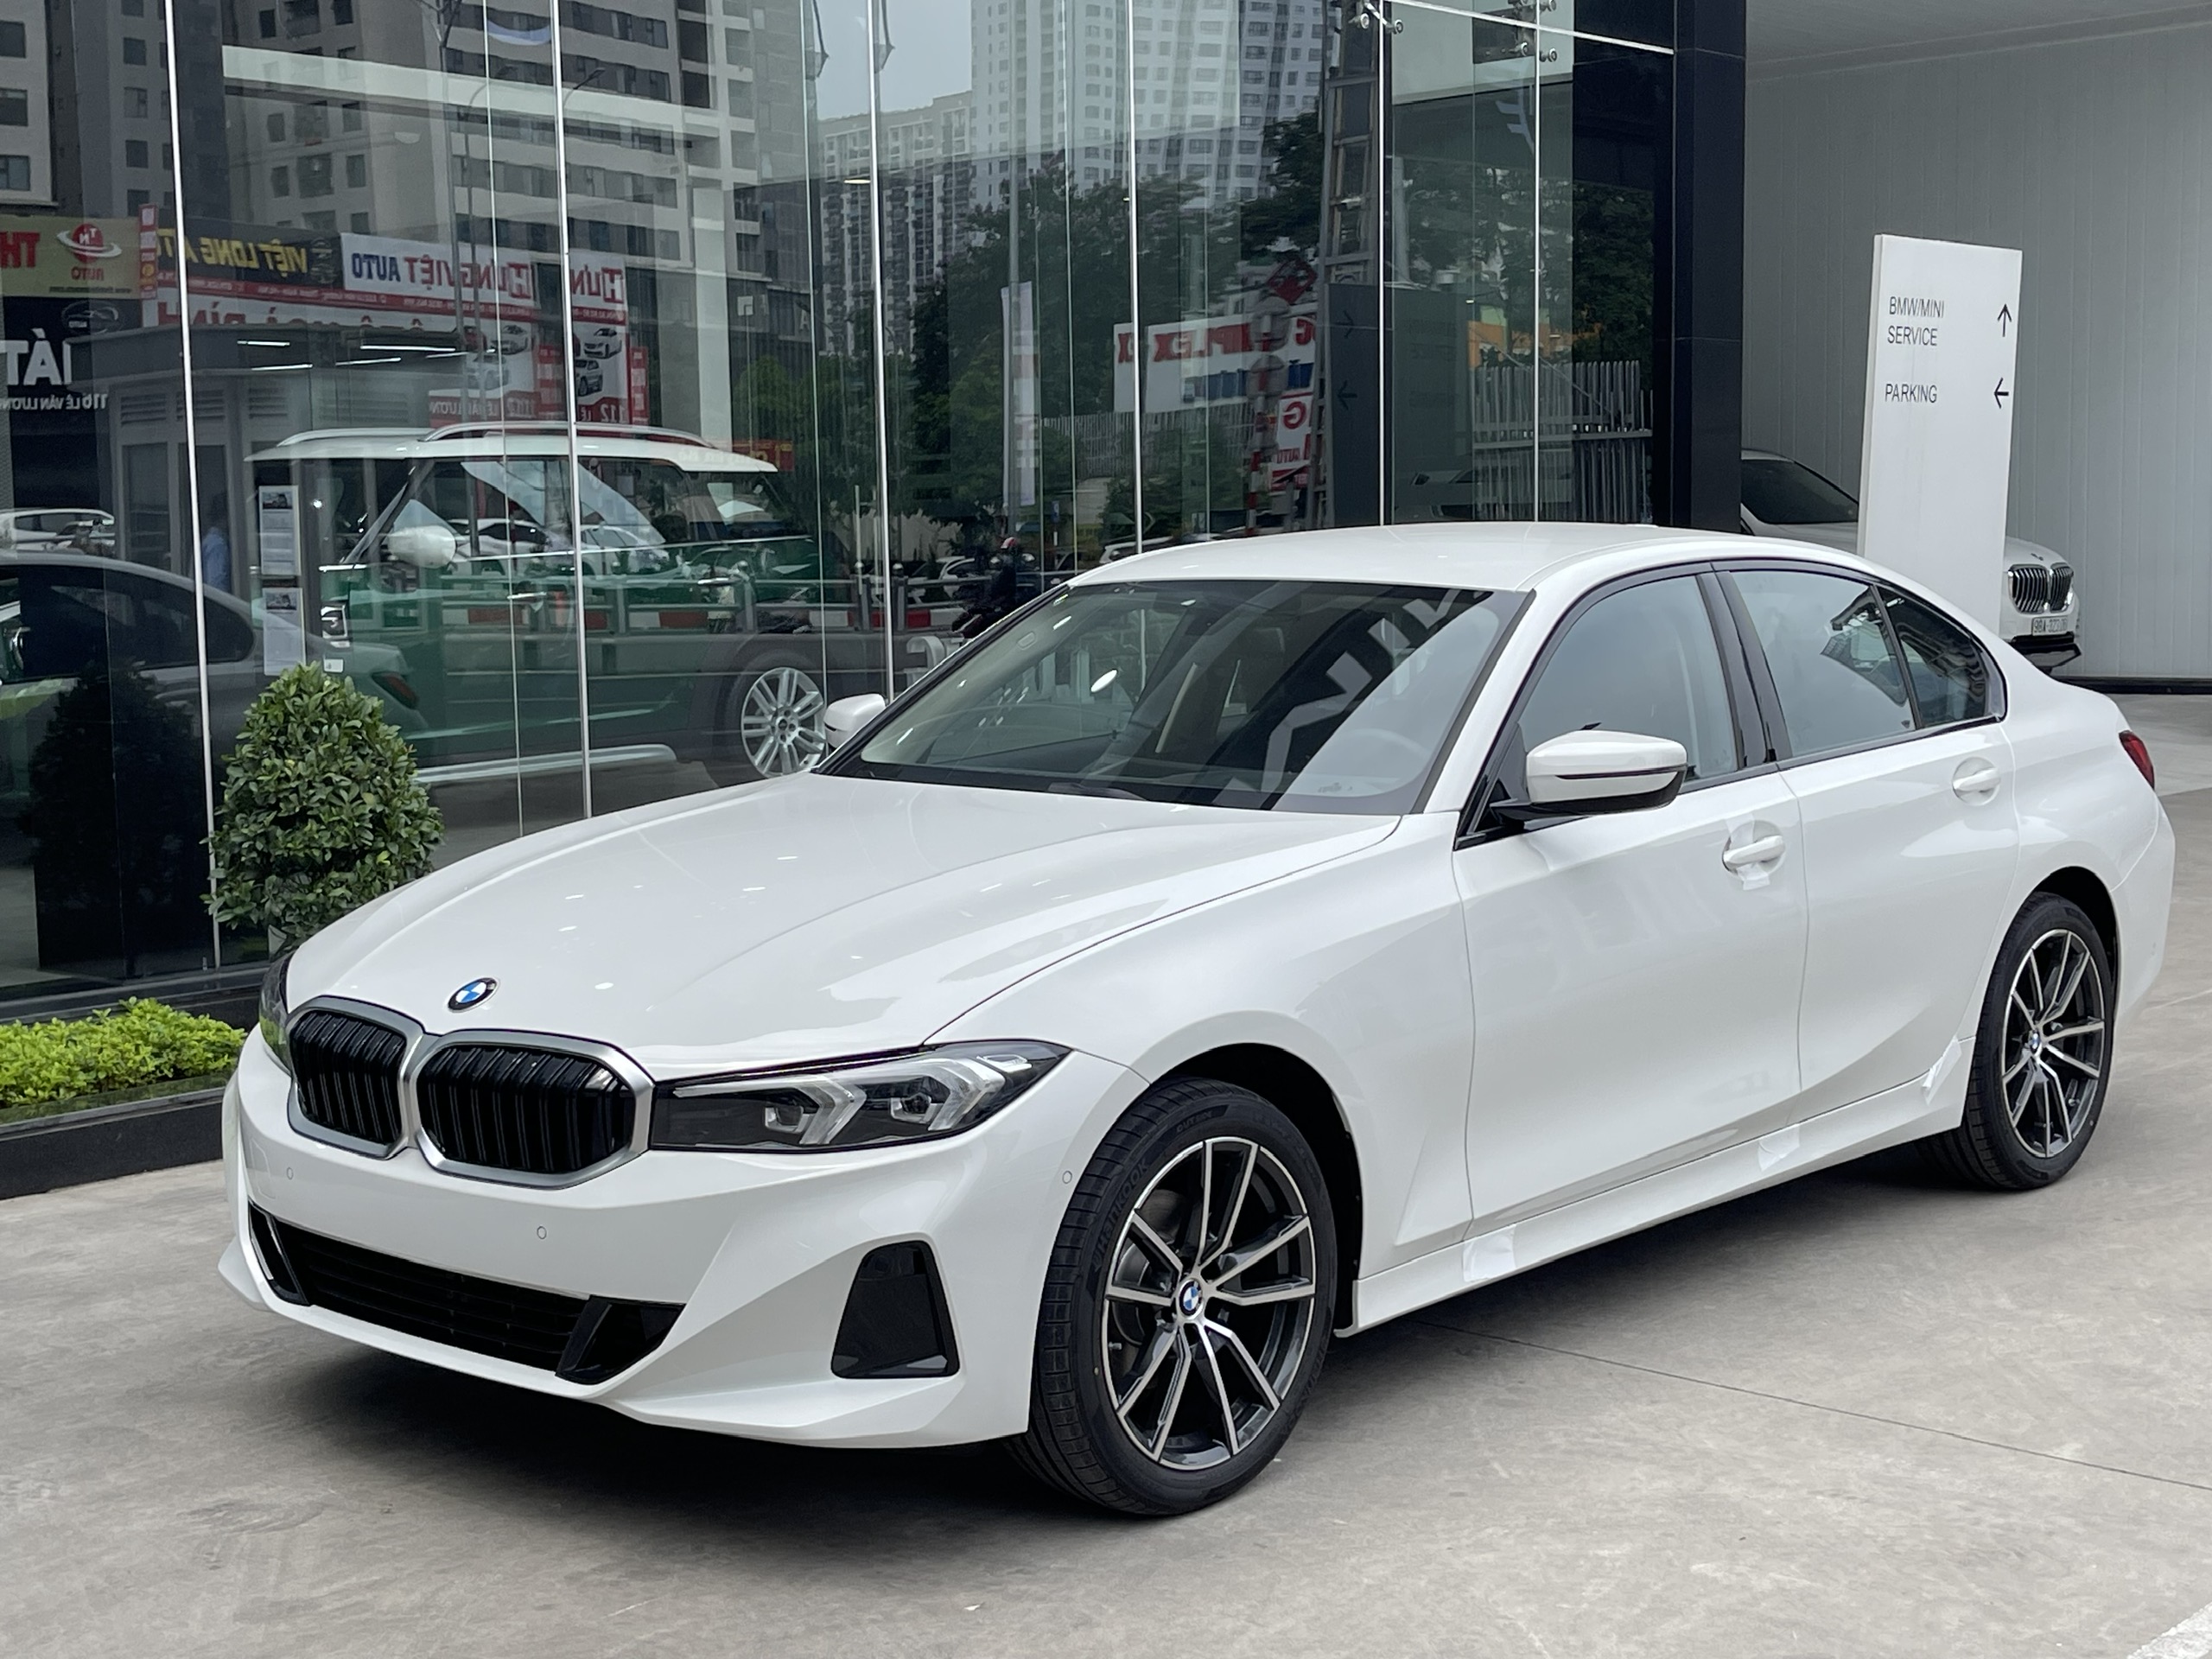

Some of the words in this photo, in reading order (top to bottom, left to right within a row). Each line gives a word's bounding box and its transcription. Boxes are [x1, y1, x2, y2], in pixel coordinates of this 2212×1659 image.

[1889, 296, 1945, 318] BMW/MINI
[1887, 325, 1938, 346] SERVICE
[1885, 383, 1938, 404] PARKING
